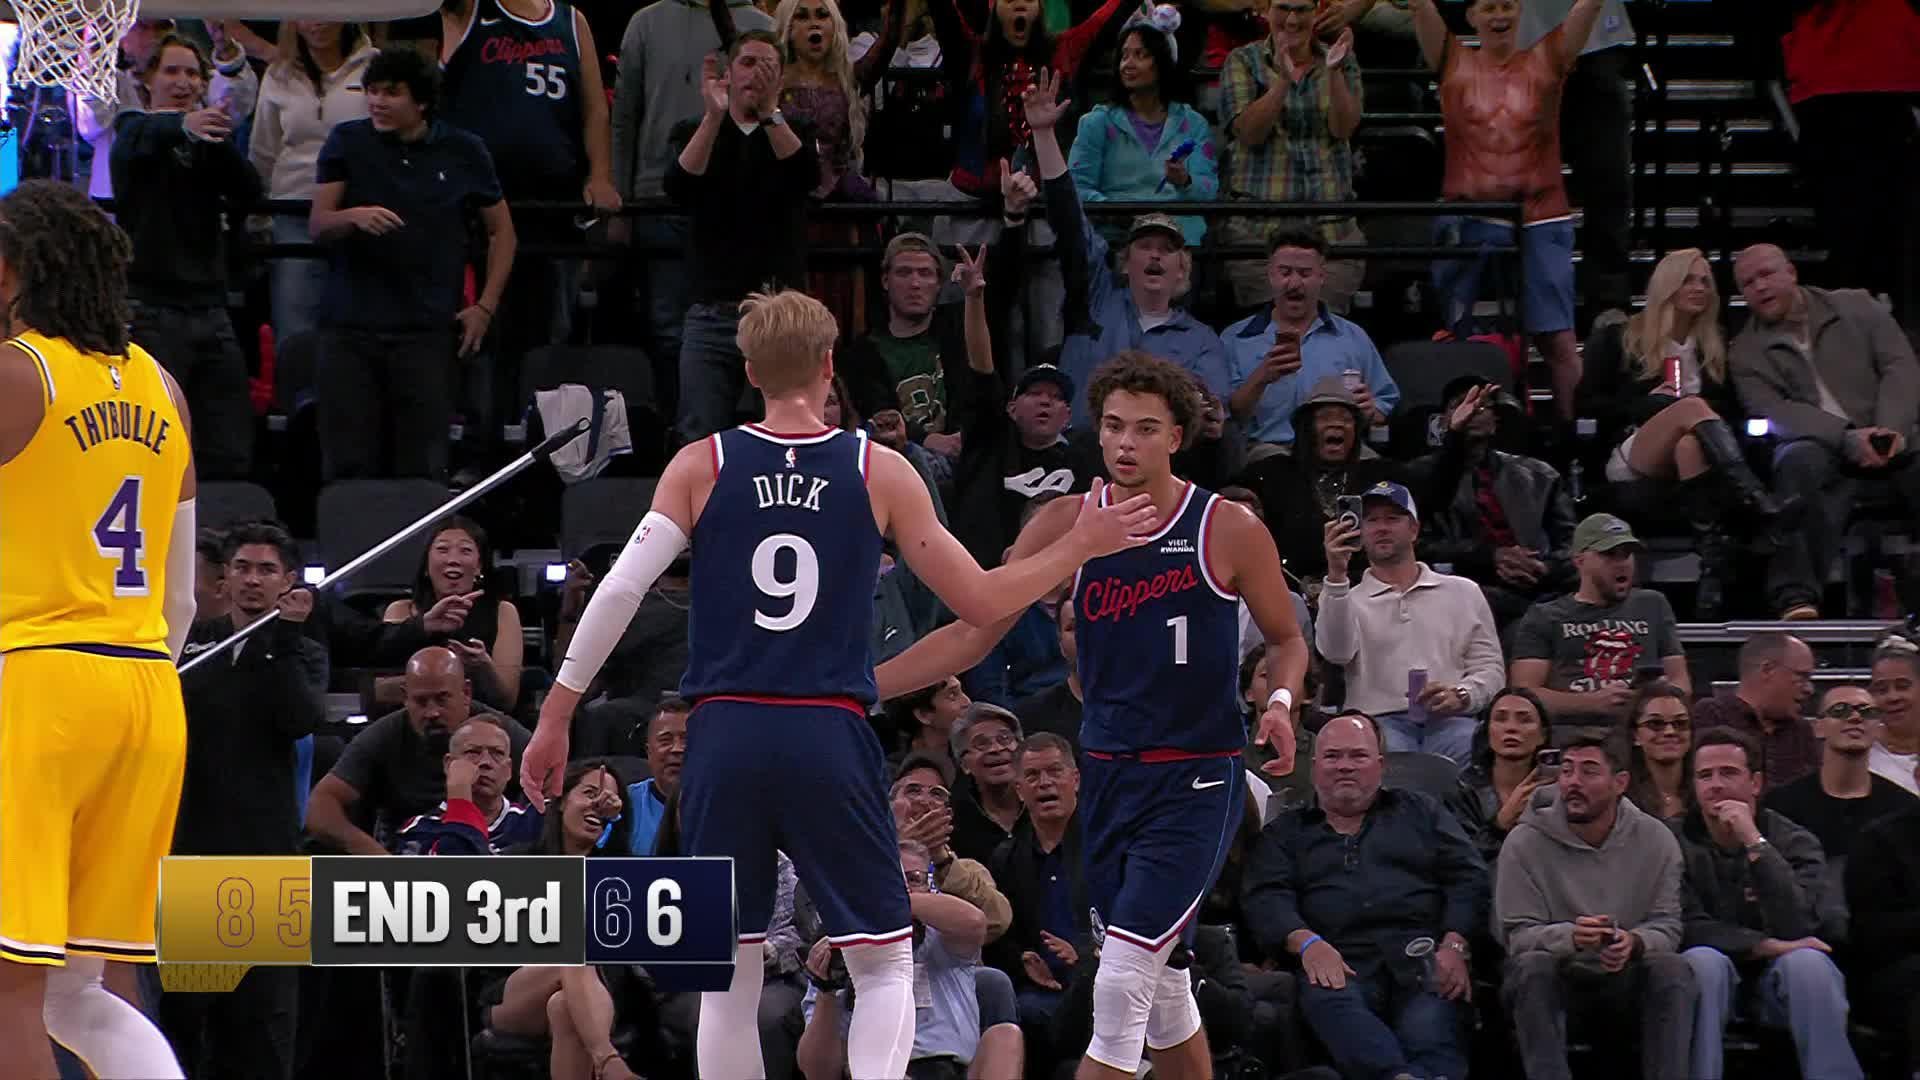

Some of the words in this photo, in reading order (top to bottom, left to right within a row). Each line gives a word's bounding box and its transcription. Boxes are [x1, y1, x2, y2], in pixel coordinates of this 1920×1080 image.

[481, 36, 568, 64] Clippers
[526, 62, 567, 99] 55
[64, 400, 170, 454] THYBULLE
[753, 473, 829, 512] DICK
[91, 474, 149, 597] 4
[751, 533, 820, 632] 9
[1083, 563, 1199, 623] Clippers
[1166, 615, 1188, 665] 1
[1562, 619, 1649, 639] ROLLING
